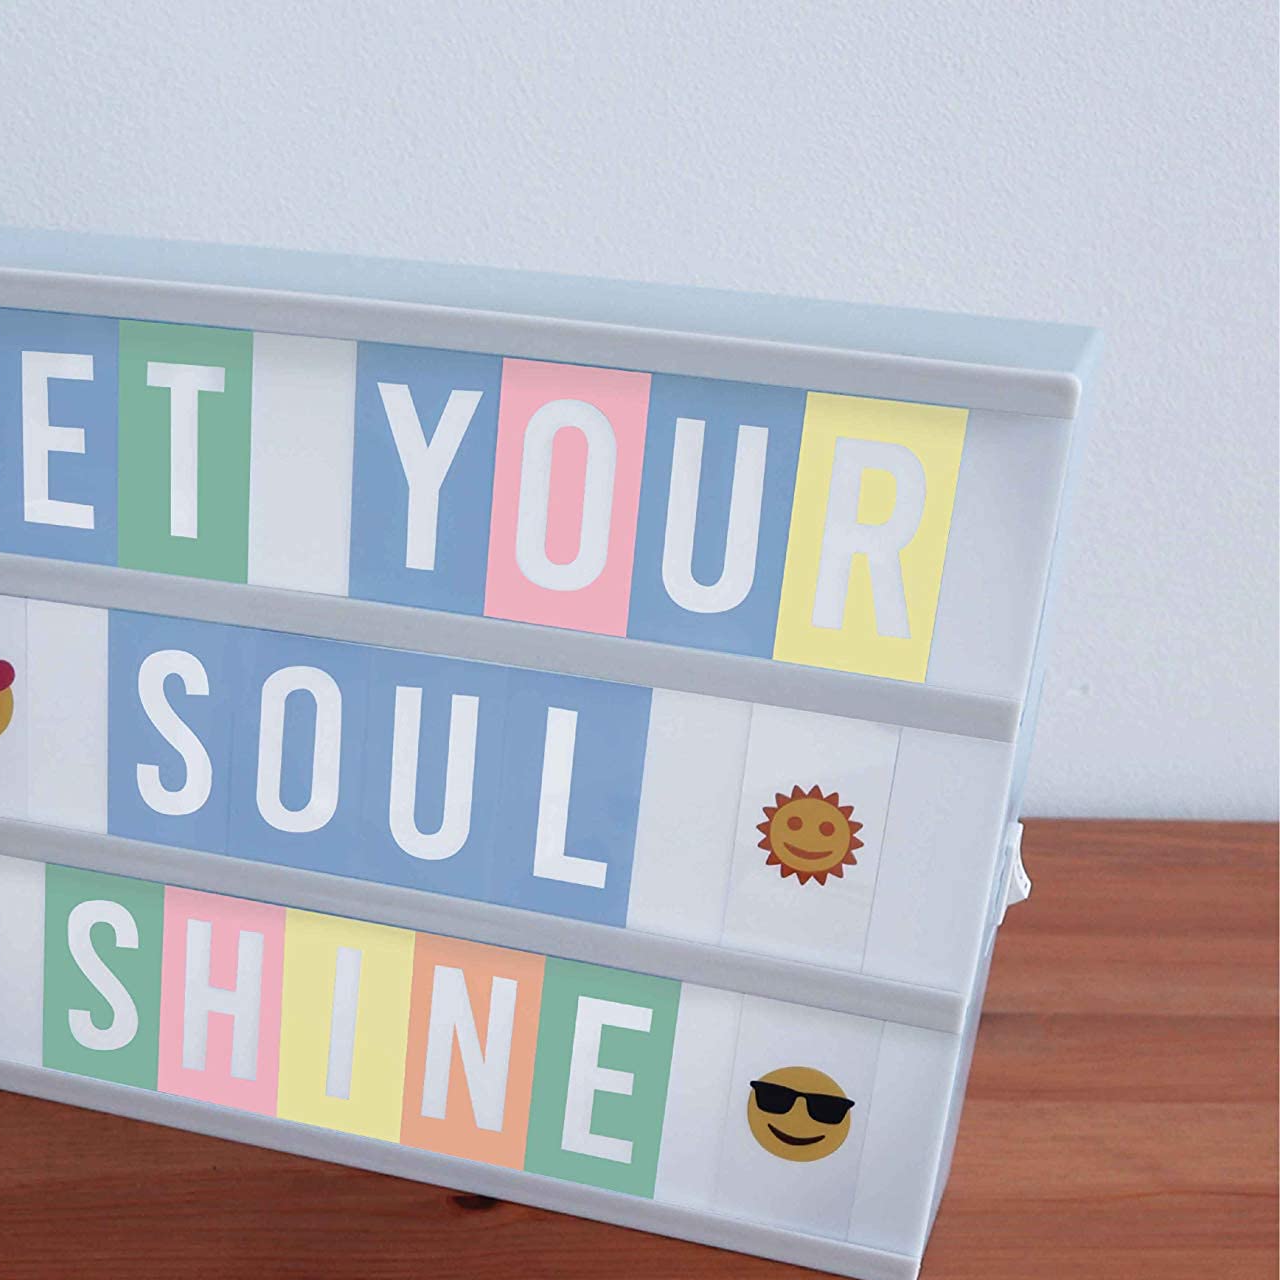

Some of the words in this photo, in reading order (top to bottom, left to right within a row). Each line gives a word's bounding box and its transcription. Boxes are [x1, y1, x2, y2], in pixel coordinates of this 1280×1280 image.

[376, 381, 928, 640] YOUR
[135, 648, 609, 890] SOUL
[65, 898, 655, 1165] SHINE
